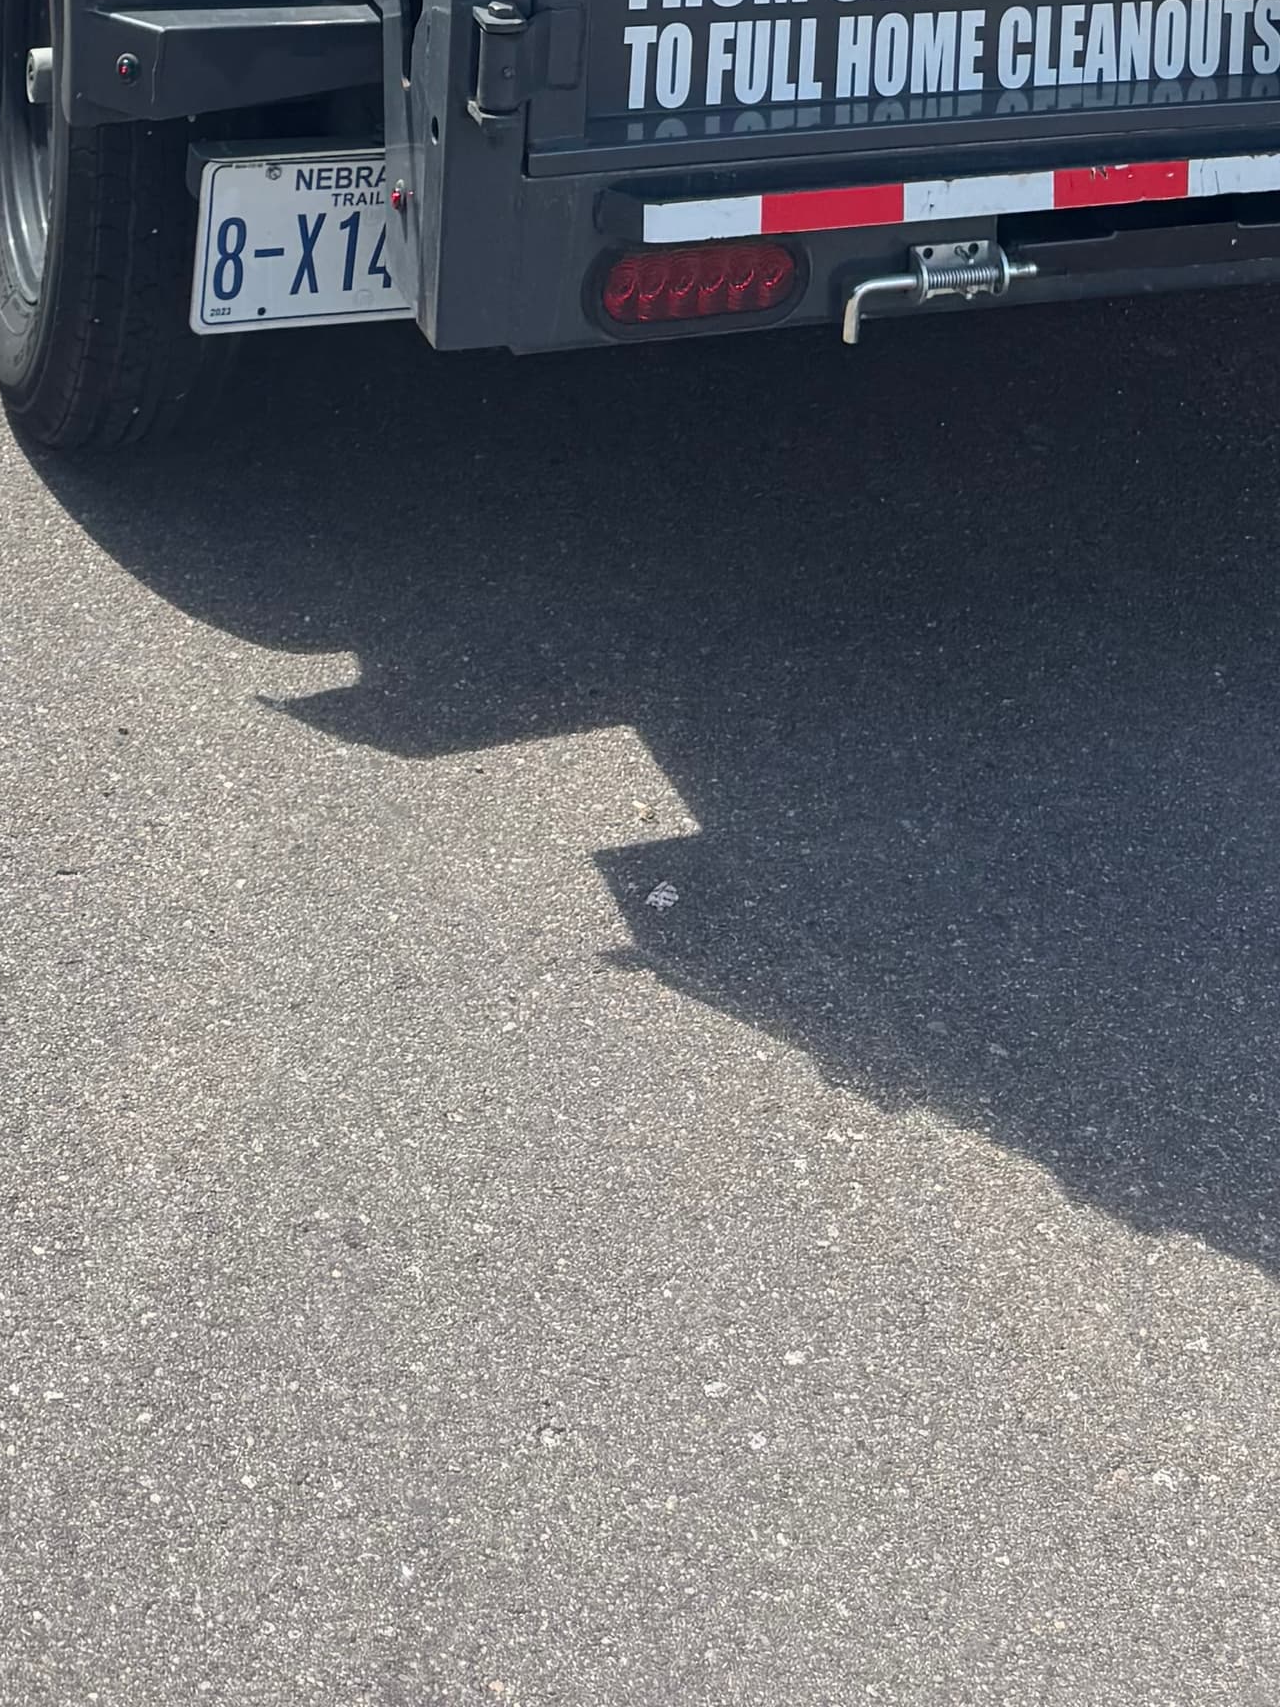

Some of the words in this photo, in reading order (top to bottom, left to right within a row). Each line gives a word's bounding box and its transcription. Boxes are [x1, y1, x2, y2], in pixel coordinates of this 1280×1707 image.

[624, 22, 694, 110] TO
[706, 18, 822, 106] FULL
[836, 10, 985, 99] HOME
[295, 166, 386, 191] NEBRA
[332, 191, 385, 207] TRAIL
